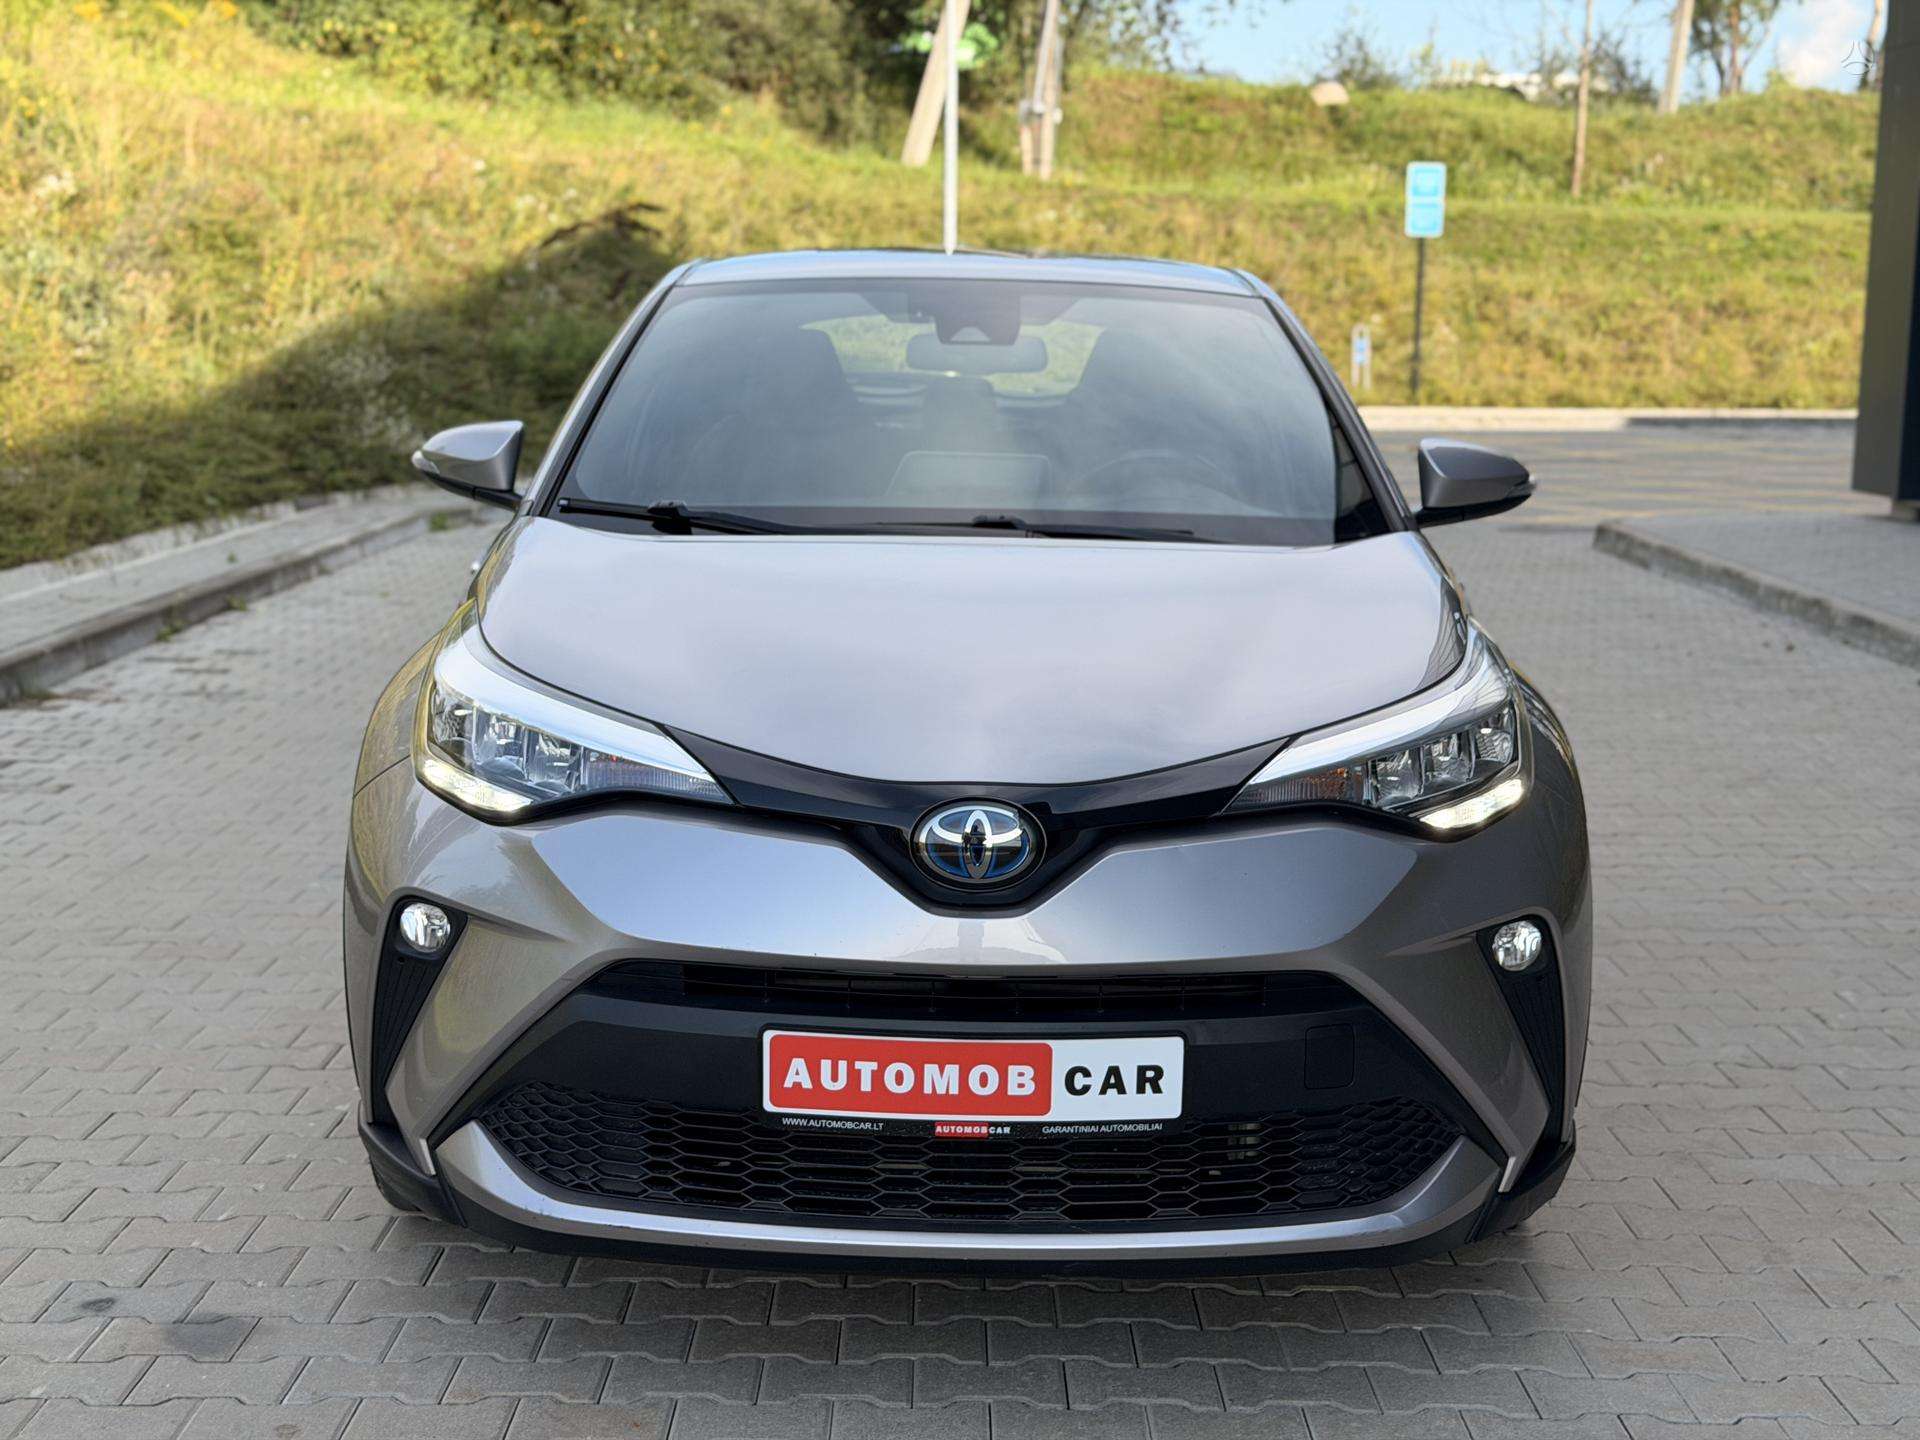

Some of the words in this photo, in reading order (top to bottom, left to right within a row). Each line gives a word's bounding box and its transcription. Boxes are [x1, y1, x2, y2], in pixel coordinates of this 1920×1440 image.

[783, 1057, 1036, 1096] AUTOMOB
[1064, 1065, 1164, 1096] CAR
[782, 1117, 884, 1131] WWW.AUTOMOBCAR.LT
[1042, 1124, 1099, 1134] GARANTINIAI
[1100, 1123, 1163, 1134] AUTOMOBILIAI
